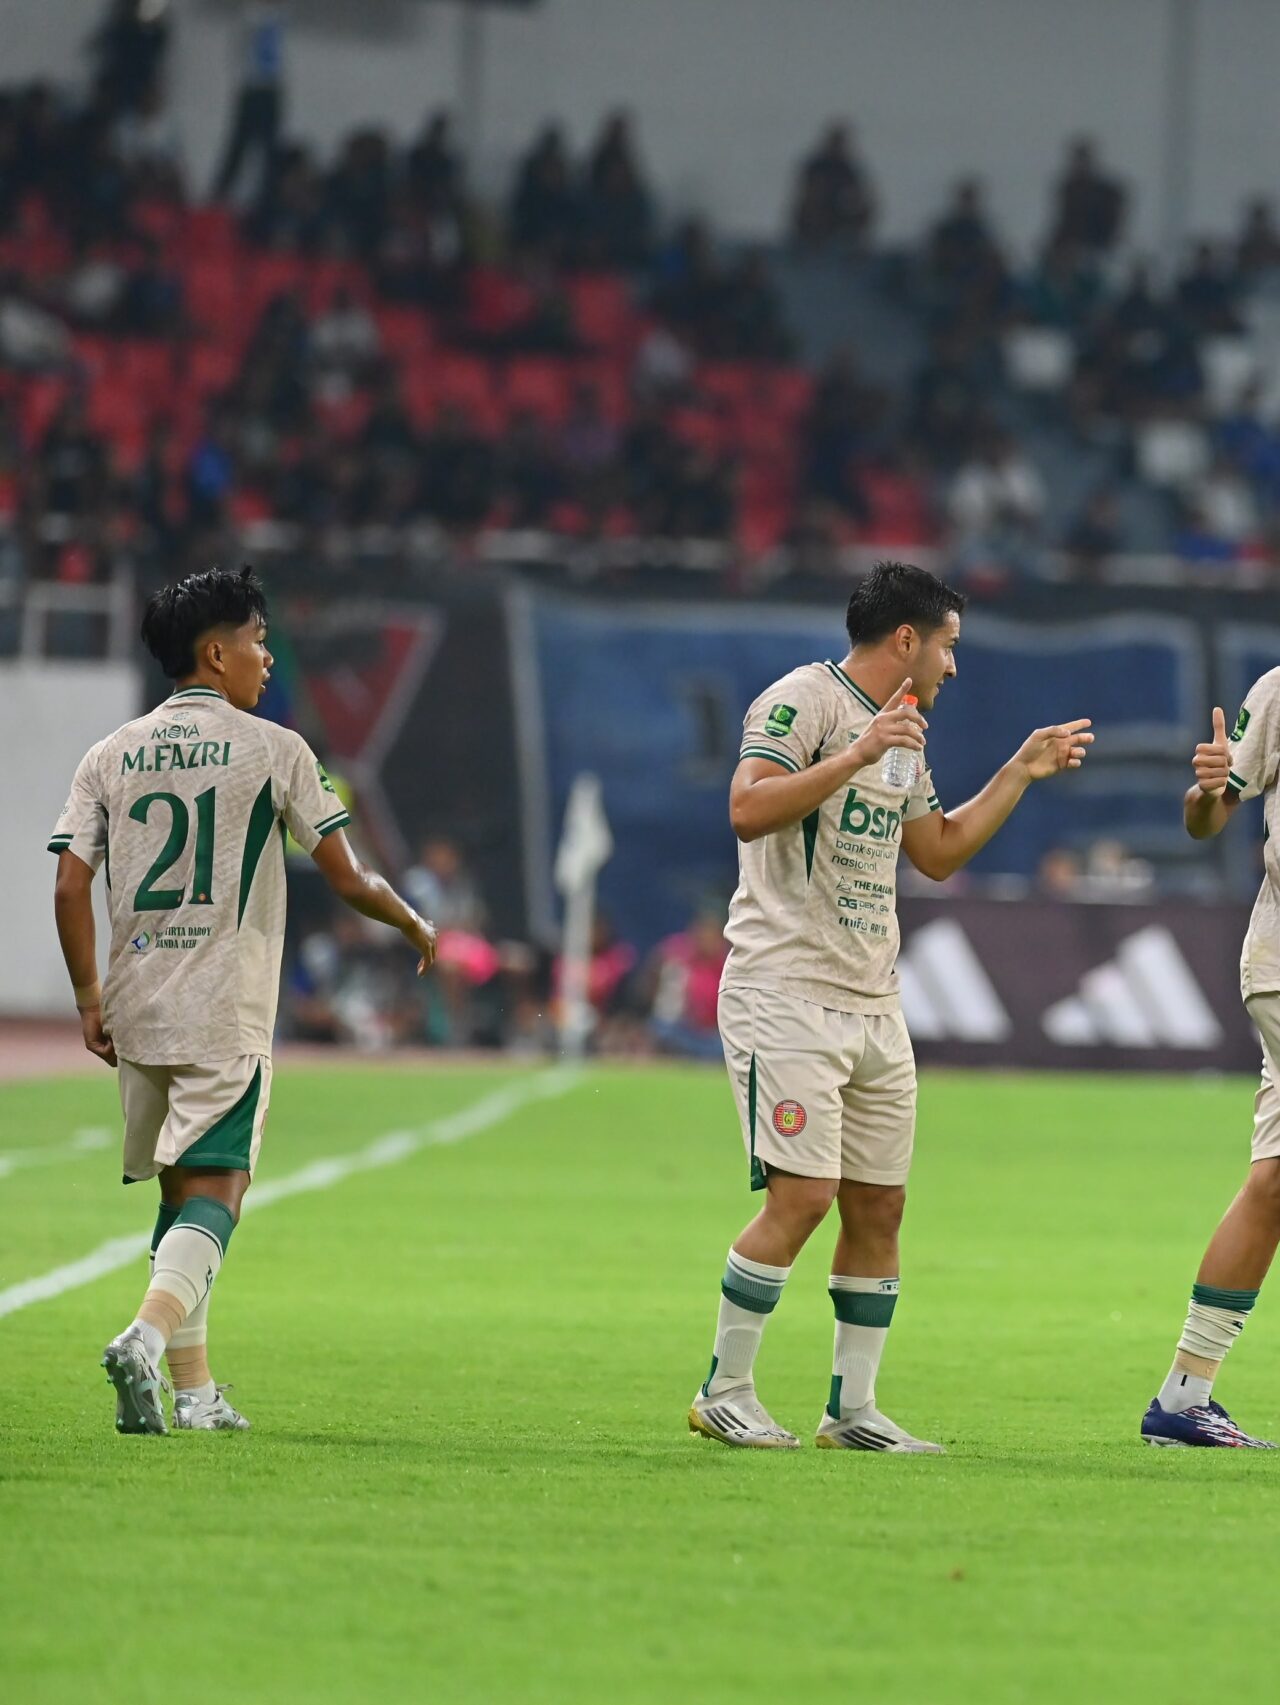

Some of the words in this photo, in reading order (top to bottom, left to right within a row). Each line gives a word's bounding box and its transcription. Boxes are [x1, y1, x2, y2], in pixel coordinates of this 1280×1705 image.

[121, 741, 231, 775] M.FAZRI
[840, 787, 898, 843] bsn
[128, 786, 215, 912] 21
[835, 837, 865, 854] bank
[831, 855, 877, 872] nasional
[854, 880, 872, 891] THE
[838, 896, 858, 910] DG
